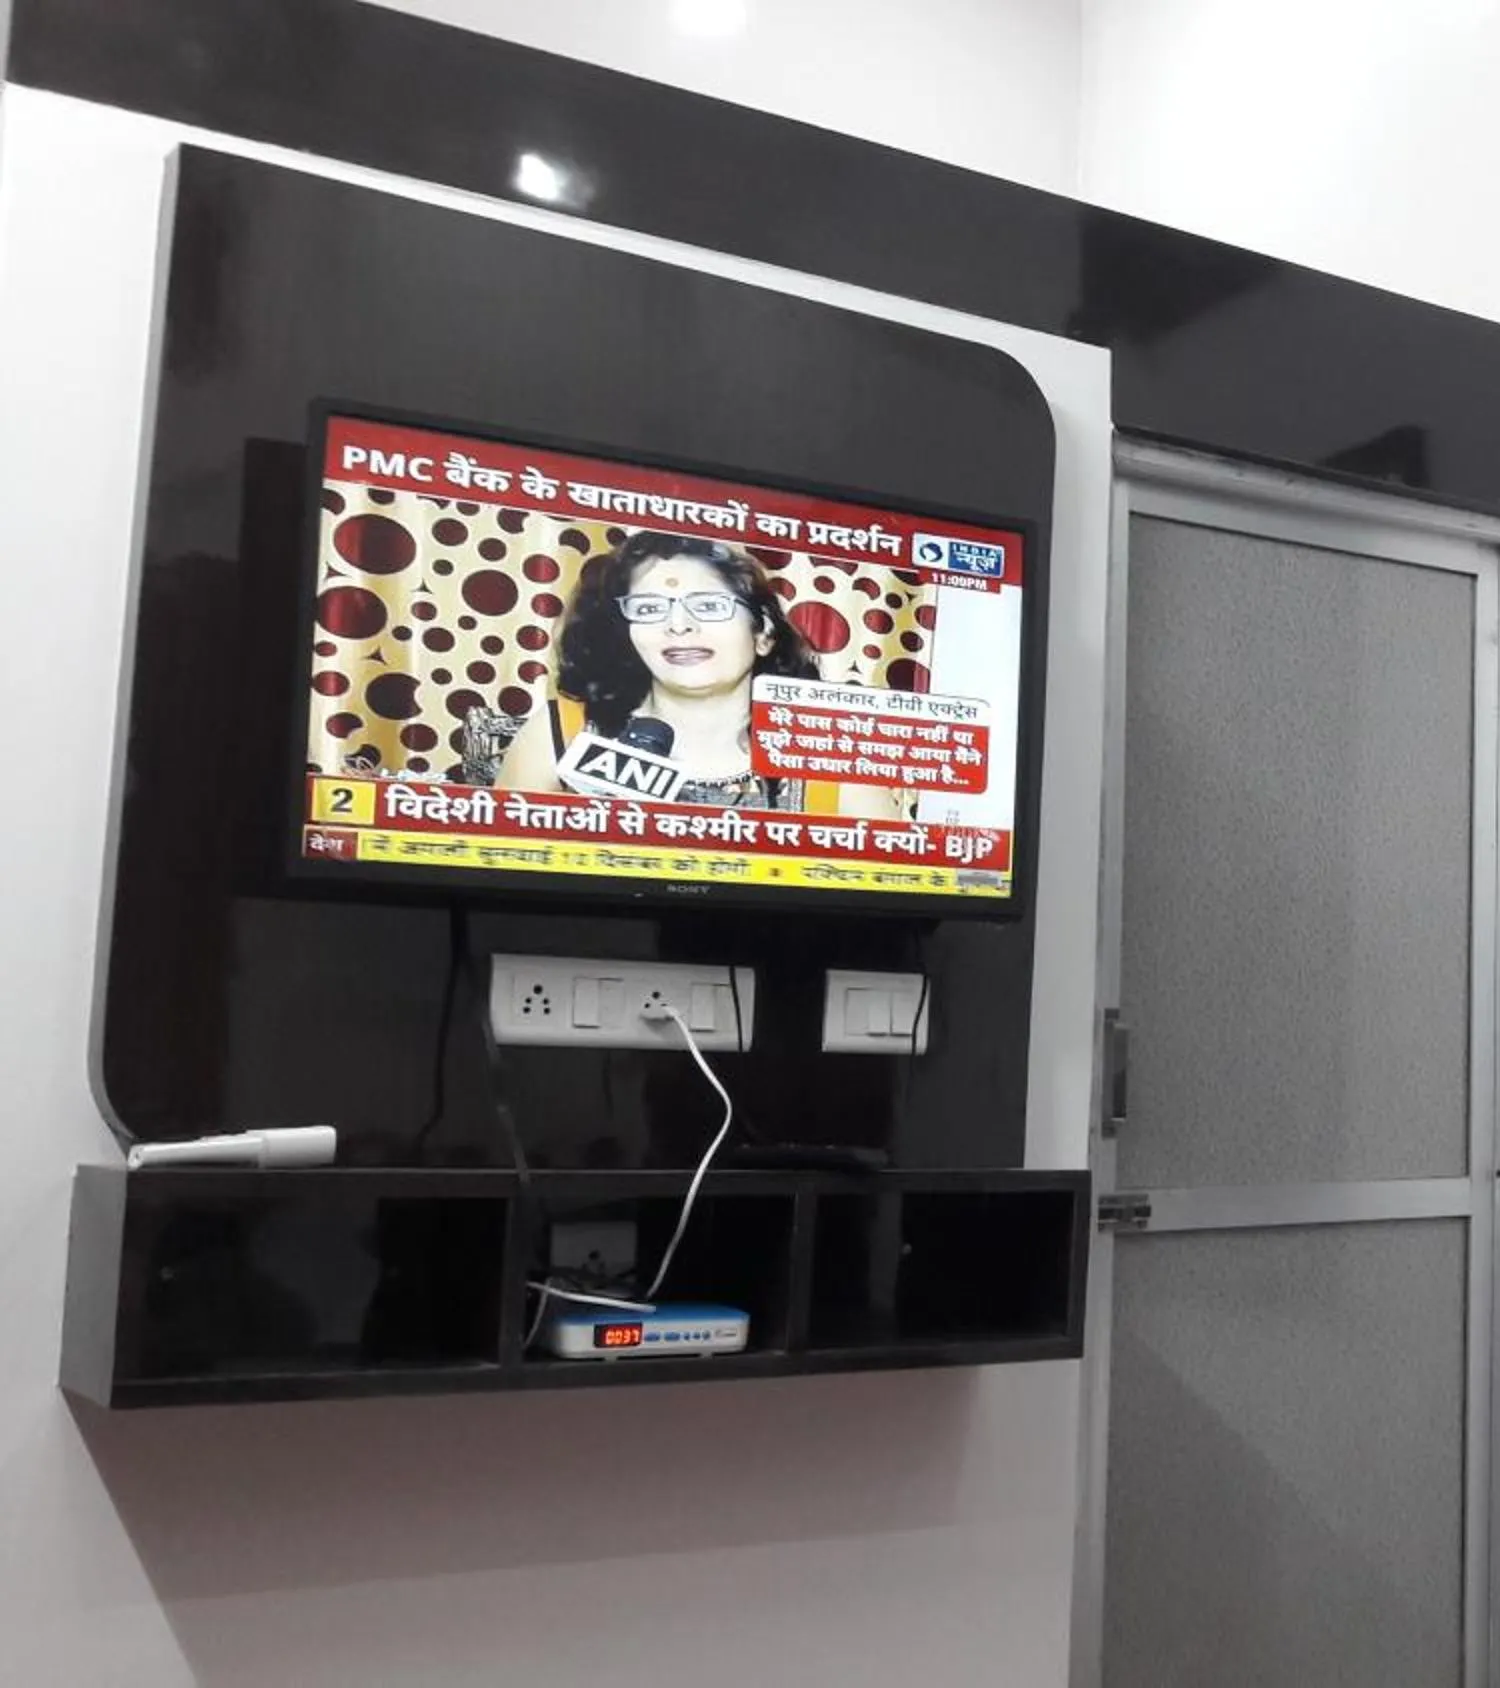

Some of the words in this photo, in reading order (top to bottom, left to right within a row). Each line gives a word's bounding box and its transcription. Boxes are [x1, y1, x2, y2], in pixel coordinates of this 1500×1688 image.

[343, 445, 434, 482] PMC
[443, 451, 512, 493] बैंक
[520, 465, 560, 501] के
[566, 481, 748, 531] खाताधारकों
[755, 512, 800, 540] का
[807, 524, 902, 557] प्रदर्शन
[797, 711, 833, 730] पास
[837, 737, 854, 753] से
[578, 749, 674, 798] ANI
[331, 787, 353, 813] 2
[384, 783, 498, 826] विदेशी
[504, 793, 611, 833] नेताओं
[617, 800, 648, 836] से
[654, 810, 761, 844] कश्मीर
[763, 821, 802, 847] पर
[807, 821, 869, 851] चर्चा
[945, 835, 994, 863] BJP
